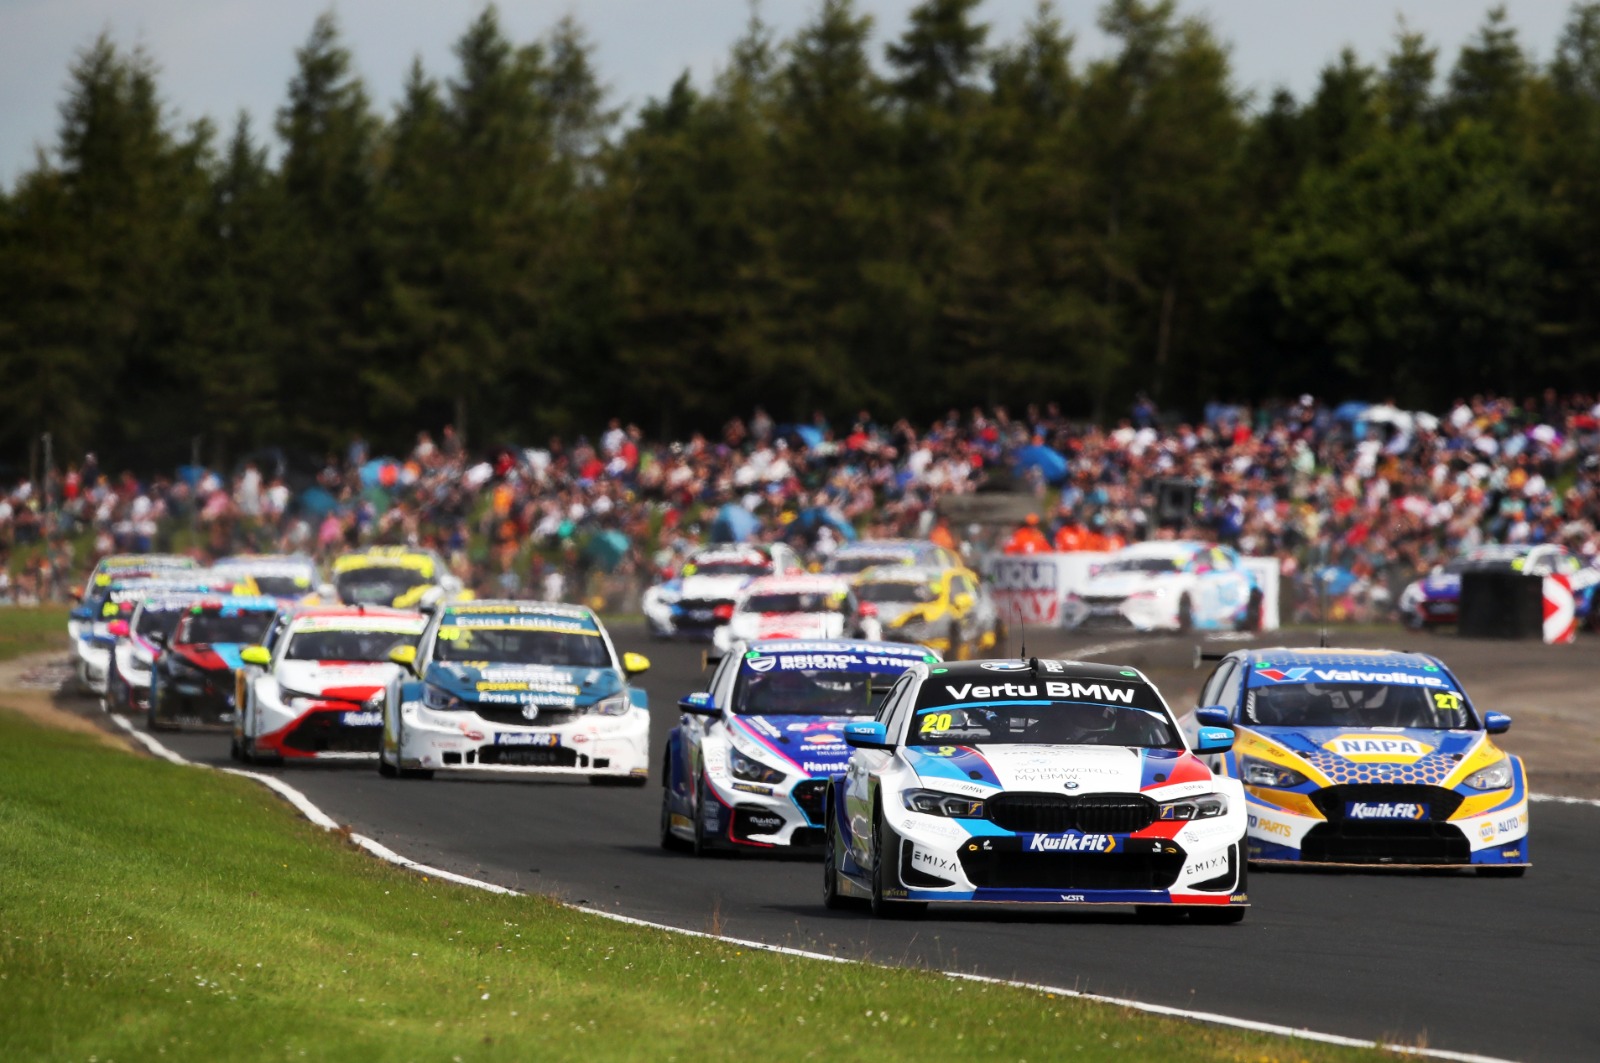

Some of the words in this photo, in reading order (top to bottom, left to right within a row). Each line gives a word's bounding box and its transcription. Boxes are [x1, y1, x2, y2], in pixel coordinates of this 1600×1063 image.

[455, 616, 507, 630] Evans
[780, 654, 862, 665] BRISTOL
[781, 661, 847, 670] MOTORS
[1314, 669, 1442, 687] Valvoline
[479, 691, 517, 704] Evans
[945, 683, 1038, 700] Vertu
[1045, 682, 1135, 703] BMW
[1434, 693, 1458, 710] 27
[920, 713, 952, 732] 20
[1341, 740, 1418, 753] NAPA
[1015, 774, 1036, 782] My
[1257, 817, 1292, 838] PARTS
[1498, 816, 1519, 833] AUTO
[914, 851, 957, 872] EMIXA
[1060, 894, 1085, 902] WSR
